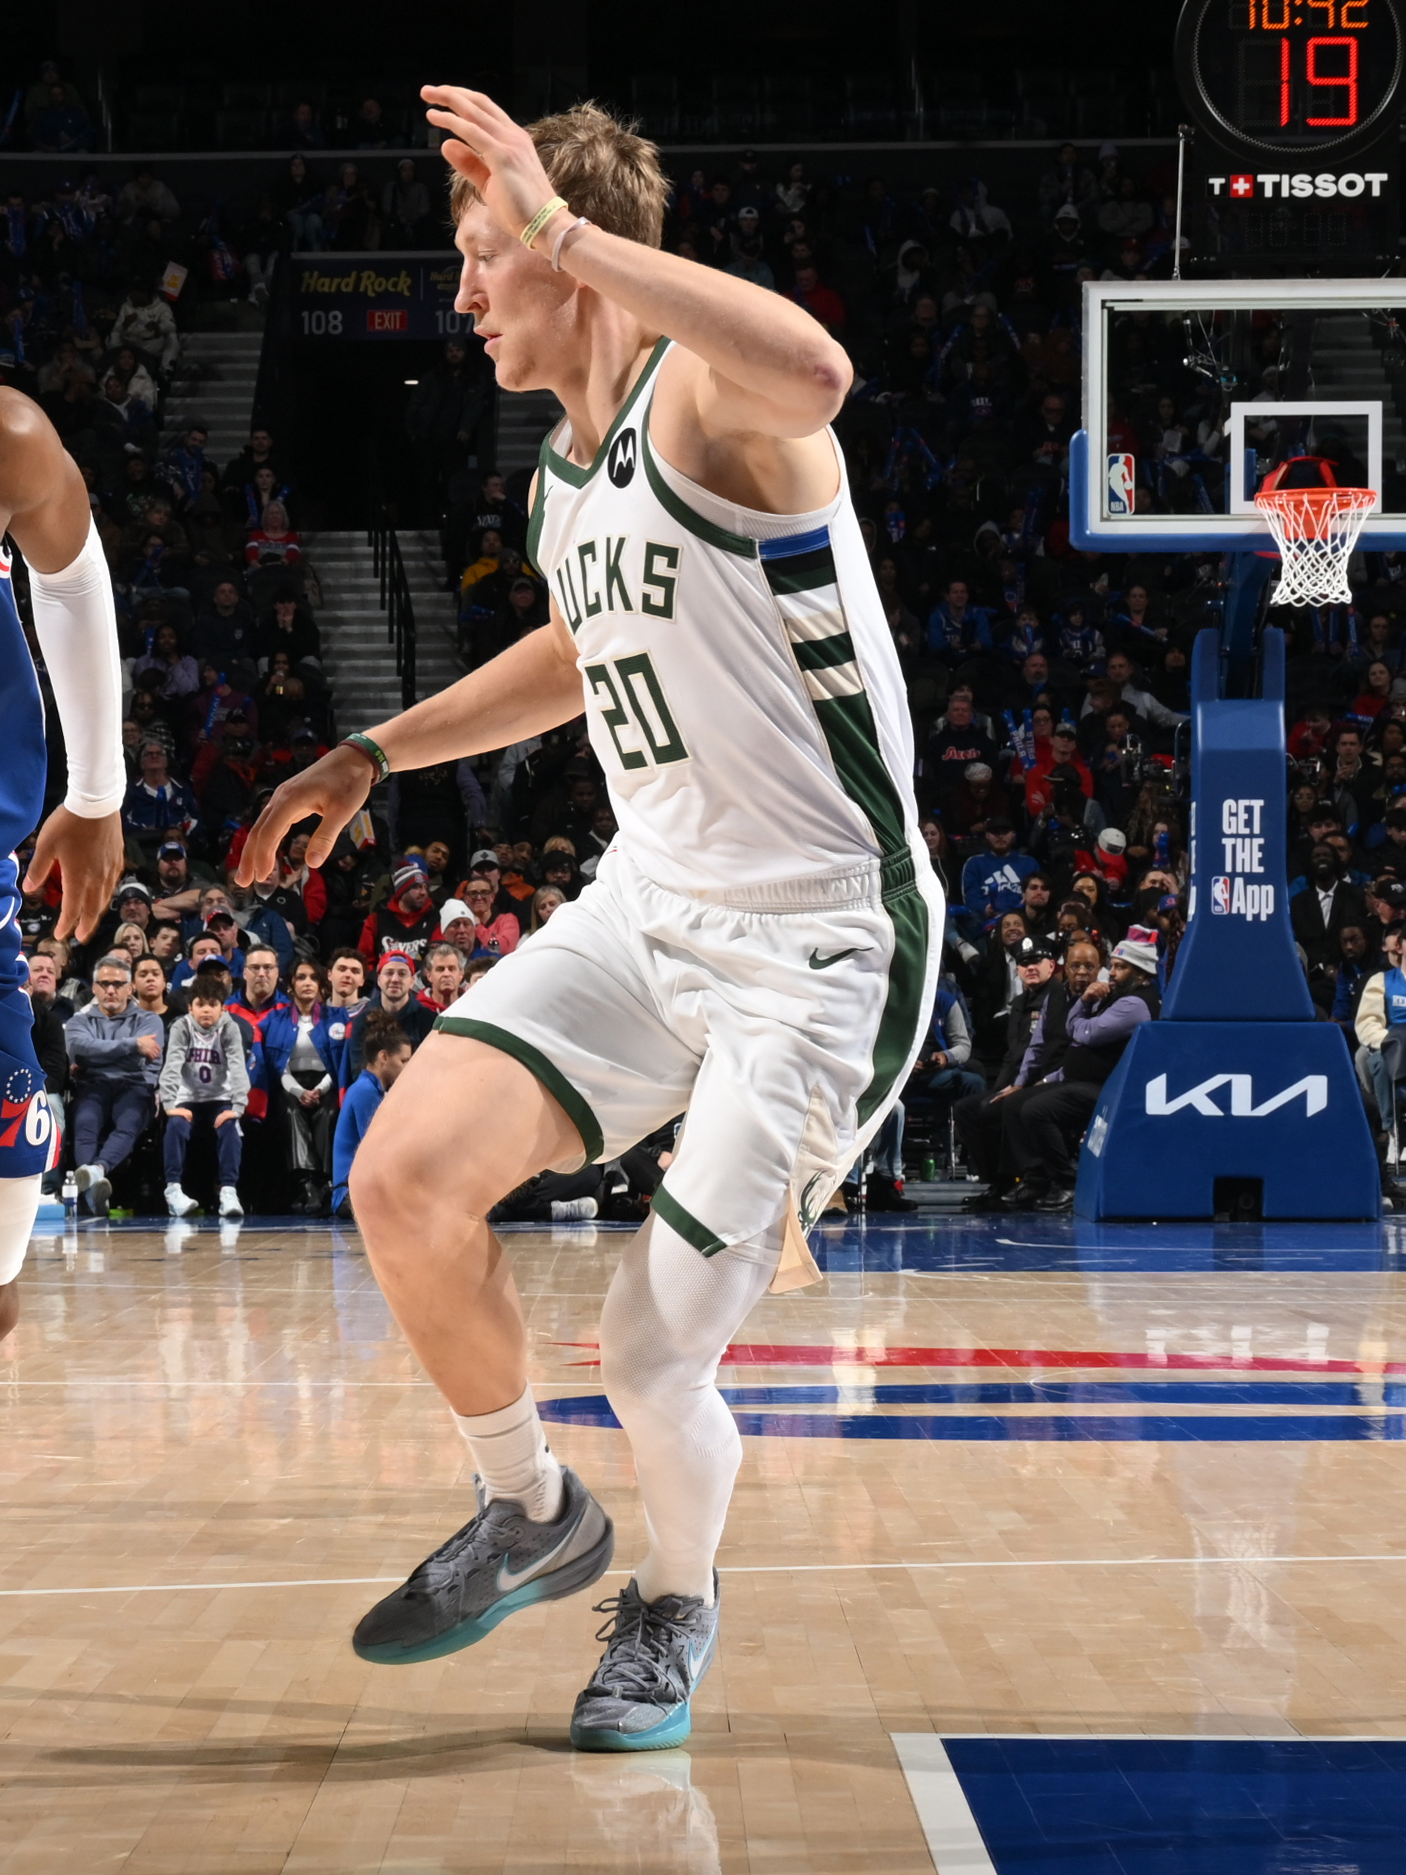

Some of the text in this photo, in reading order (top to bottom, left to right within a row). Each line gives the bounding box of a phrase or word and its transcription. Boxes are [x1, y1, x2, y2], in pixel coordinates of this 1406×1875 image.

[1280, 36, 1359, 127] 19
[1256, 173, 1389, 198] TISSOT
[301, 270, 412, 298] Hard Rock
[301, 310, 343, 335] 108
[374, 311, 402, 330] EXIT
[555, 535, 682, 637] UCKS
[584, 651, 691, 771] 20
[1222, 799, 1265, 835] GET
[1221, 837, 1265, 873] THE
[1231, 876, 1275, 922] App
[199, 1065, 211, 1084] 0
[1146, 1072, 1328, 1118] KIA
